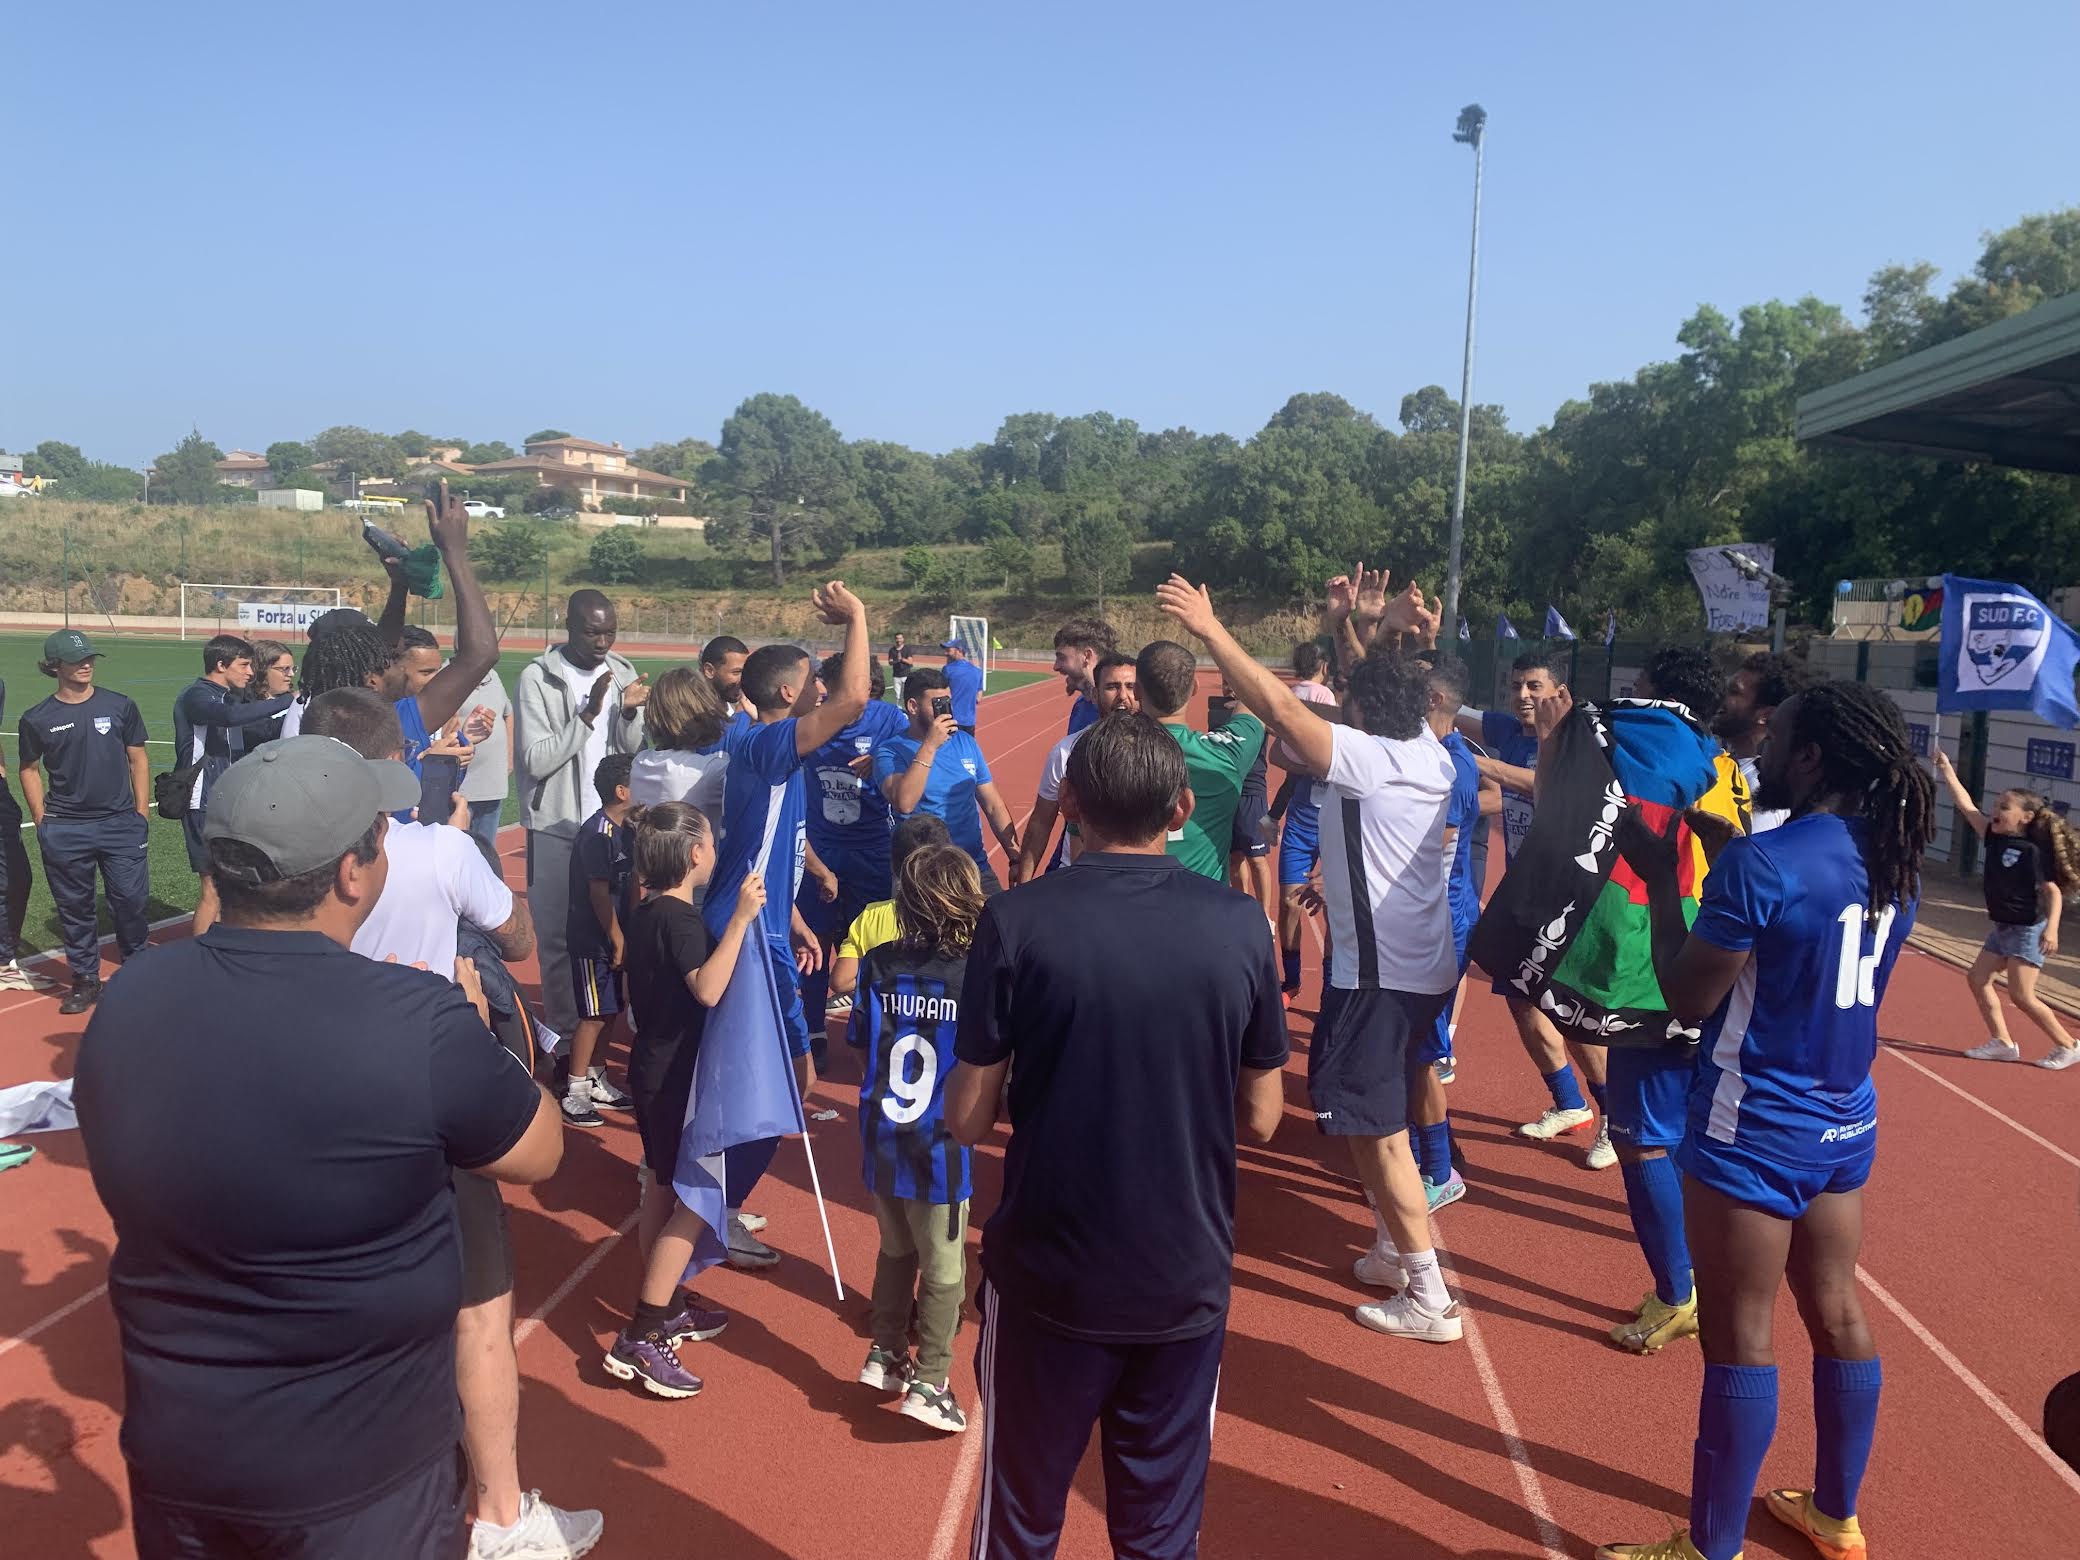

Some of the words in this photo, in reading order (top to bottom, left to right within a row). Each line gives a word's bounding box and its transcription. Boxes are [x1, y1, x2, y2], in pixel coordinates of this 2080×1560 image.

[257, 608, 293, 625] Forza
[298, 613, 306, 625] u
[1978, 607, 2009, 623] SUD
[880, 992, 958, 1022] THURAM
[881, 1033, 938, 1124] 9
